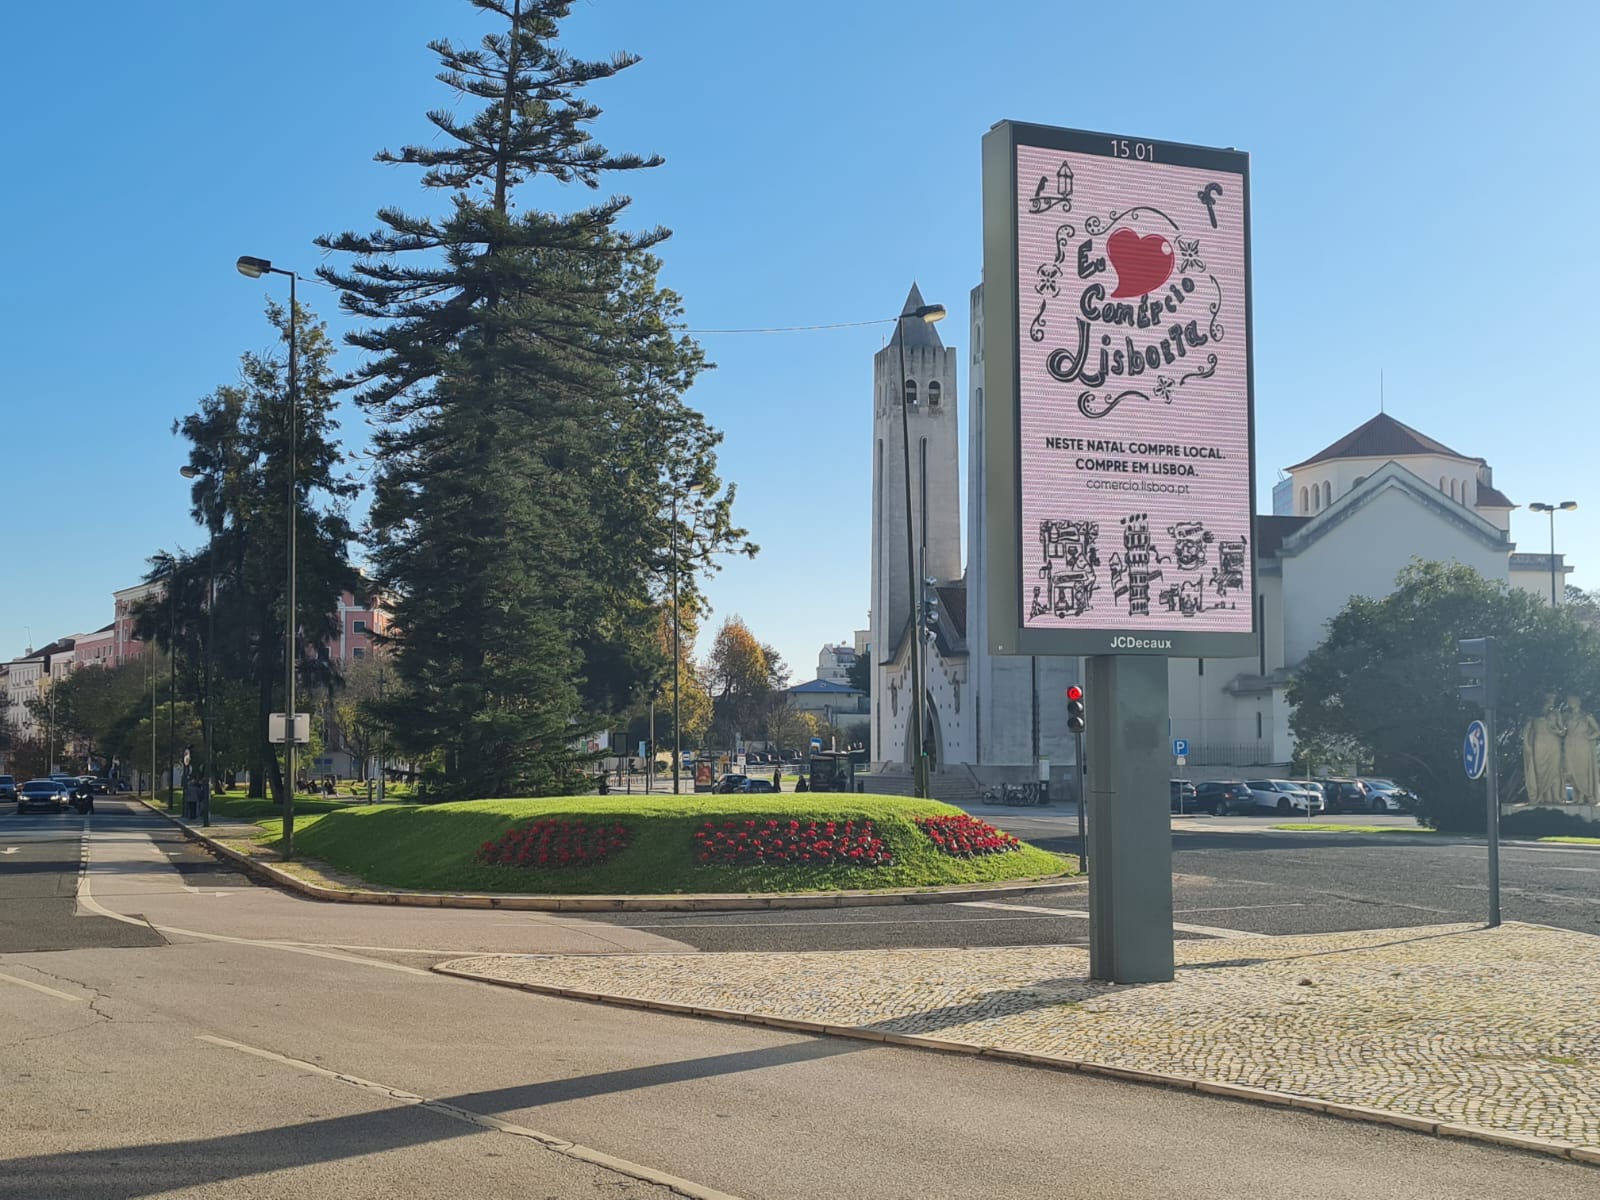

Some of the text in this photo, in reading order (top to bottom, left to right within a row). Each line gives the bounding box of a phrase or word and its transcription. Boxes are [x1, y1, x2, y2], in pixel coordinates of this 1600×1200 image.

[1111, 140, 1153, 161] 15 01
[1045, 437, 1226, 459] NESTE NATAL COMPRE LOCAL.
[1075, 458, 1199, 477] COMPRE EM LISBOA.
[1086, 479, 1190, 496] comercio.lisboa.pt
[1110, 636, 1172, 649] JCDecaux
